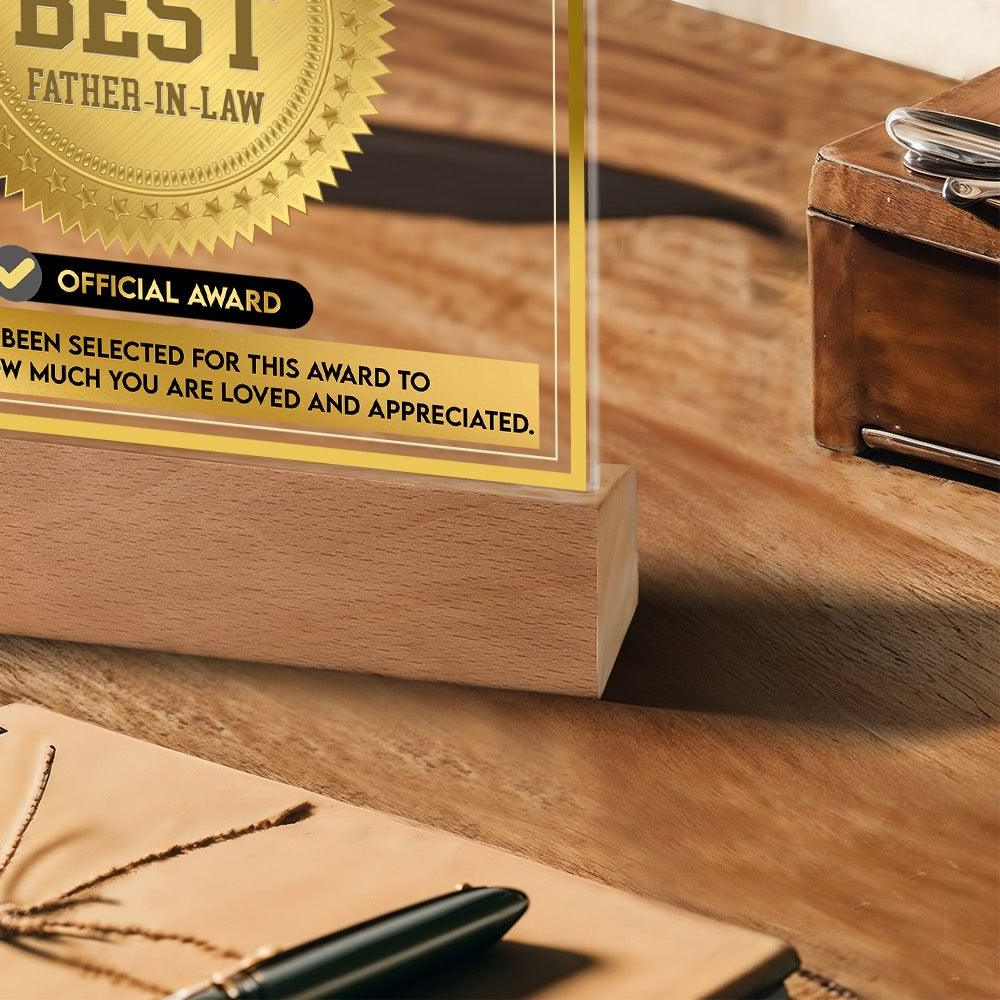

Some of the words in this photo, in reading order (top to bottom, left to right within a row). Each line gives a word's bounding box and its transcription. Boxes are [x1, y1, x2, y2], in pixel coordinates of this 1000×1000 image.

[27, 67, 265, 125] FATHER-IN-LAW
[57, 269, 179, 304] OFFICIAL
[187, 284, 281, 314] AWARD
[1, 327, 61, 354] BEEN
[69, 335, 184, 366] SELECTED
[192, 348, 240, 373] FOR
[247, 354, 299, 379] THIS
[307, 361, 391, 388] AWARD
[397, 369, 431, 393] TO
[30, 362, 101, 389] MUCH
[109, 369, 159, 395] YOU
[166, 377, 213, 401] ARE
[221, 381, 301, 409] LOVED
[307, 393, 360, 416] AND
[367, 399, 535, 436] APPRECIATED.
